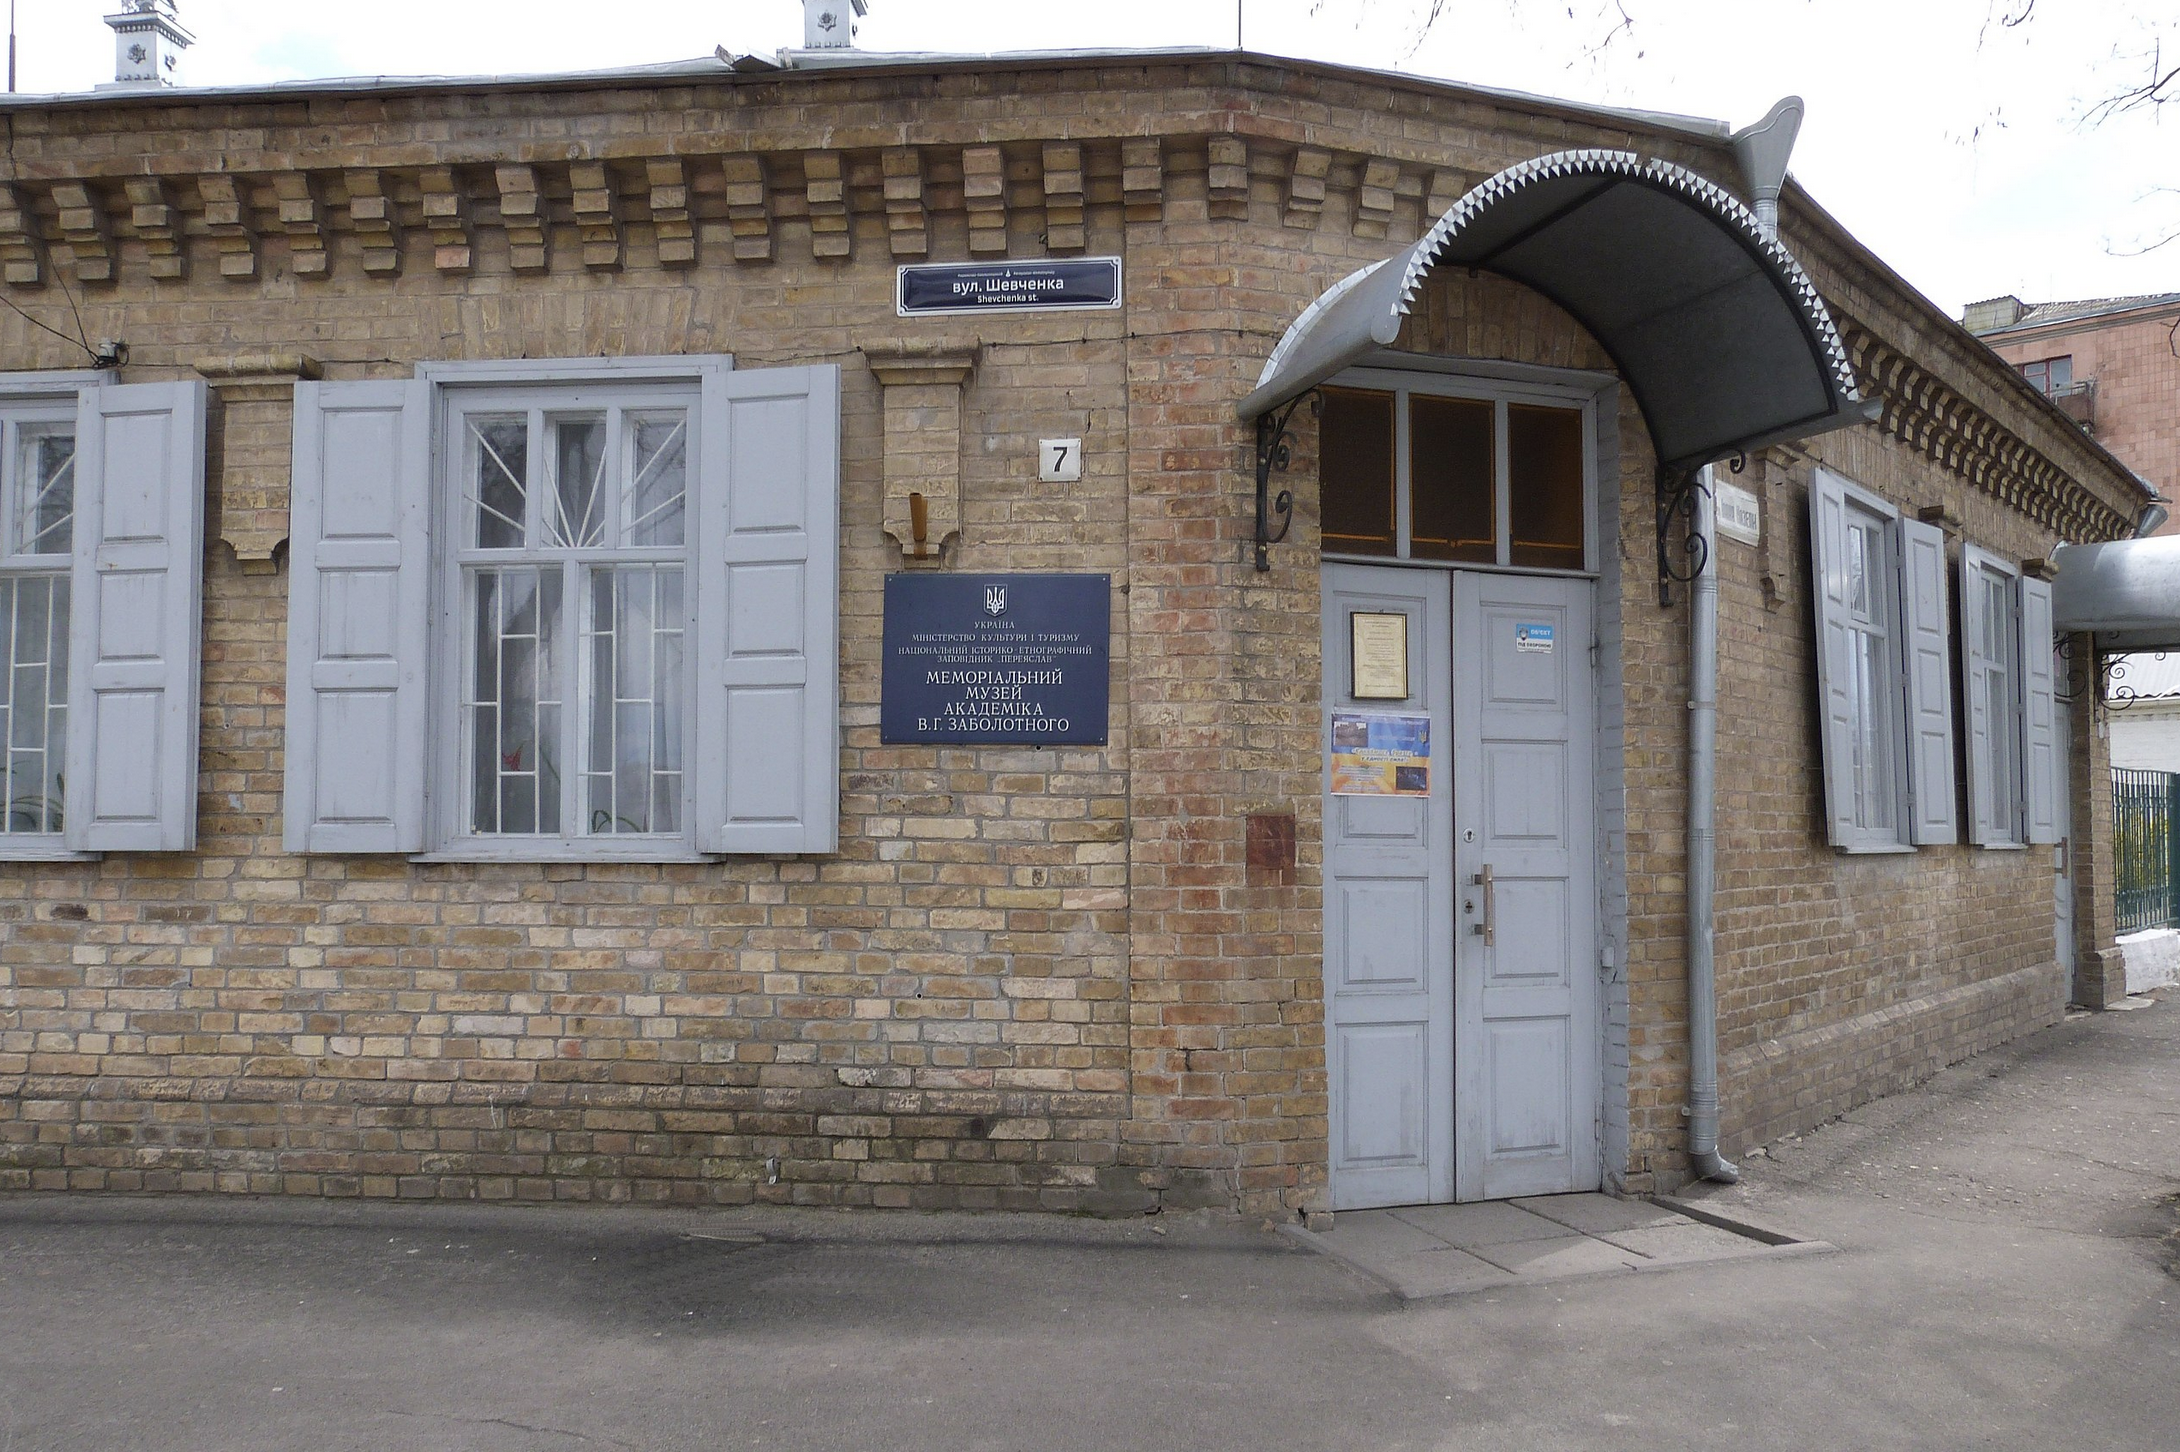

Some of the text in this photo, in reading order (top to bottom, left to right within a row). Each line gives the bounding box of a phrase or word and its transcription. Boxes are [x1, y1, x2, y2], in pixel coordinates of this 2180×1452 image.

[953, 278, 1064, 296] вул. Шевченка
[977, 293, 1039, 303] Shevchenka st.
[1053, 446, 1067, 472] 7
[974, 621, 1015, 629] УКРАЇНА
[911, 634, 976, 642] МІНІСТЕРСТВО
[981, 634, 1027, 642] КУЛЬТУРИ
[1038, 634, 1080, 642] ТУРИЗМУ
[898, 646, 968, 655] НАЦІОНАЛЬНИЙ
[937, 656, 993, 664] ЗАПОВІДНИК
[926, 668, 1063, 685] МЕМОРІАЛЬНИЙ
[965, 684, 1022, 700] МУЗЕЙ
[944, 702, 1044, 717] АКАДЕМІКА
[917, 718, 1070, 732] В.Г. ЗАБОЛОТНОГО
